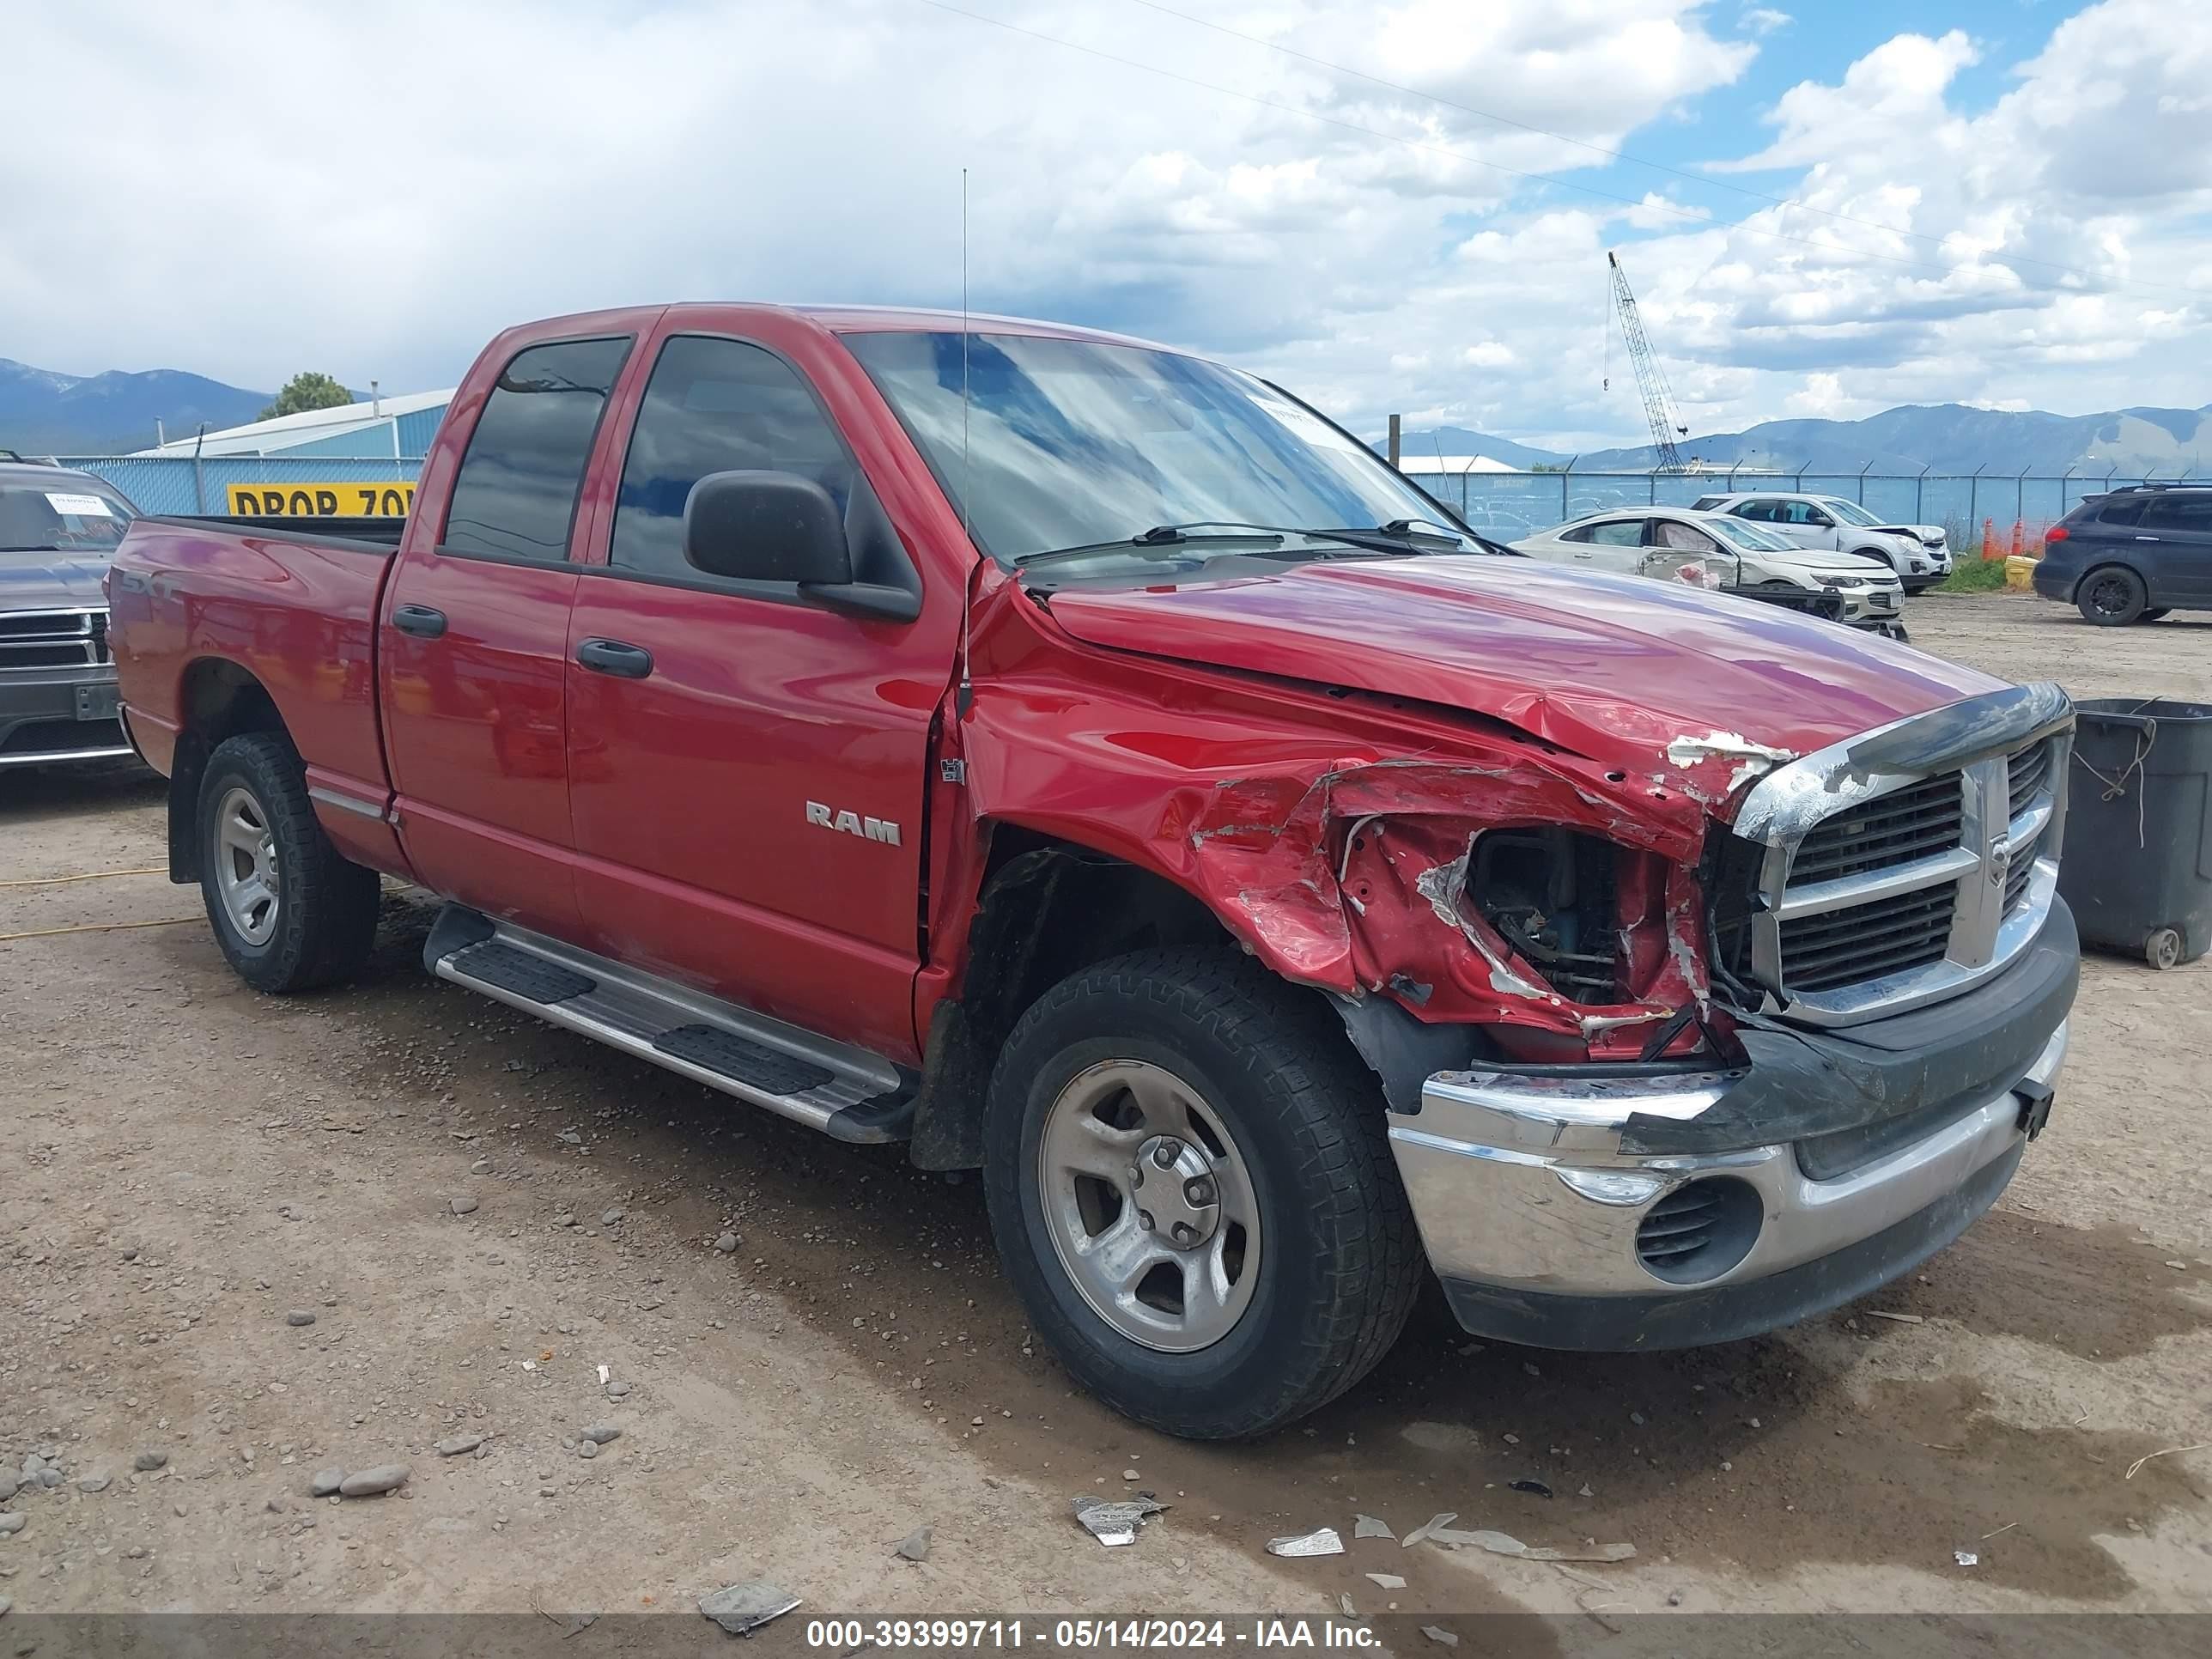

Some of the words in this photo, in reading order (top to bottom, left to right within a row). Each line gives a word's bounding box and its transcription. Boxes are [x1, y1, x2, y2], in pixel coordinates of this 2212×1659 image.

[235, 490, 337, 515] DROP
[122, 571, 185, 599] SXT
[806, 799, 902, 847] RAM
